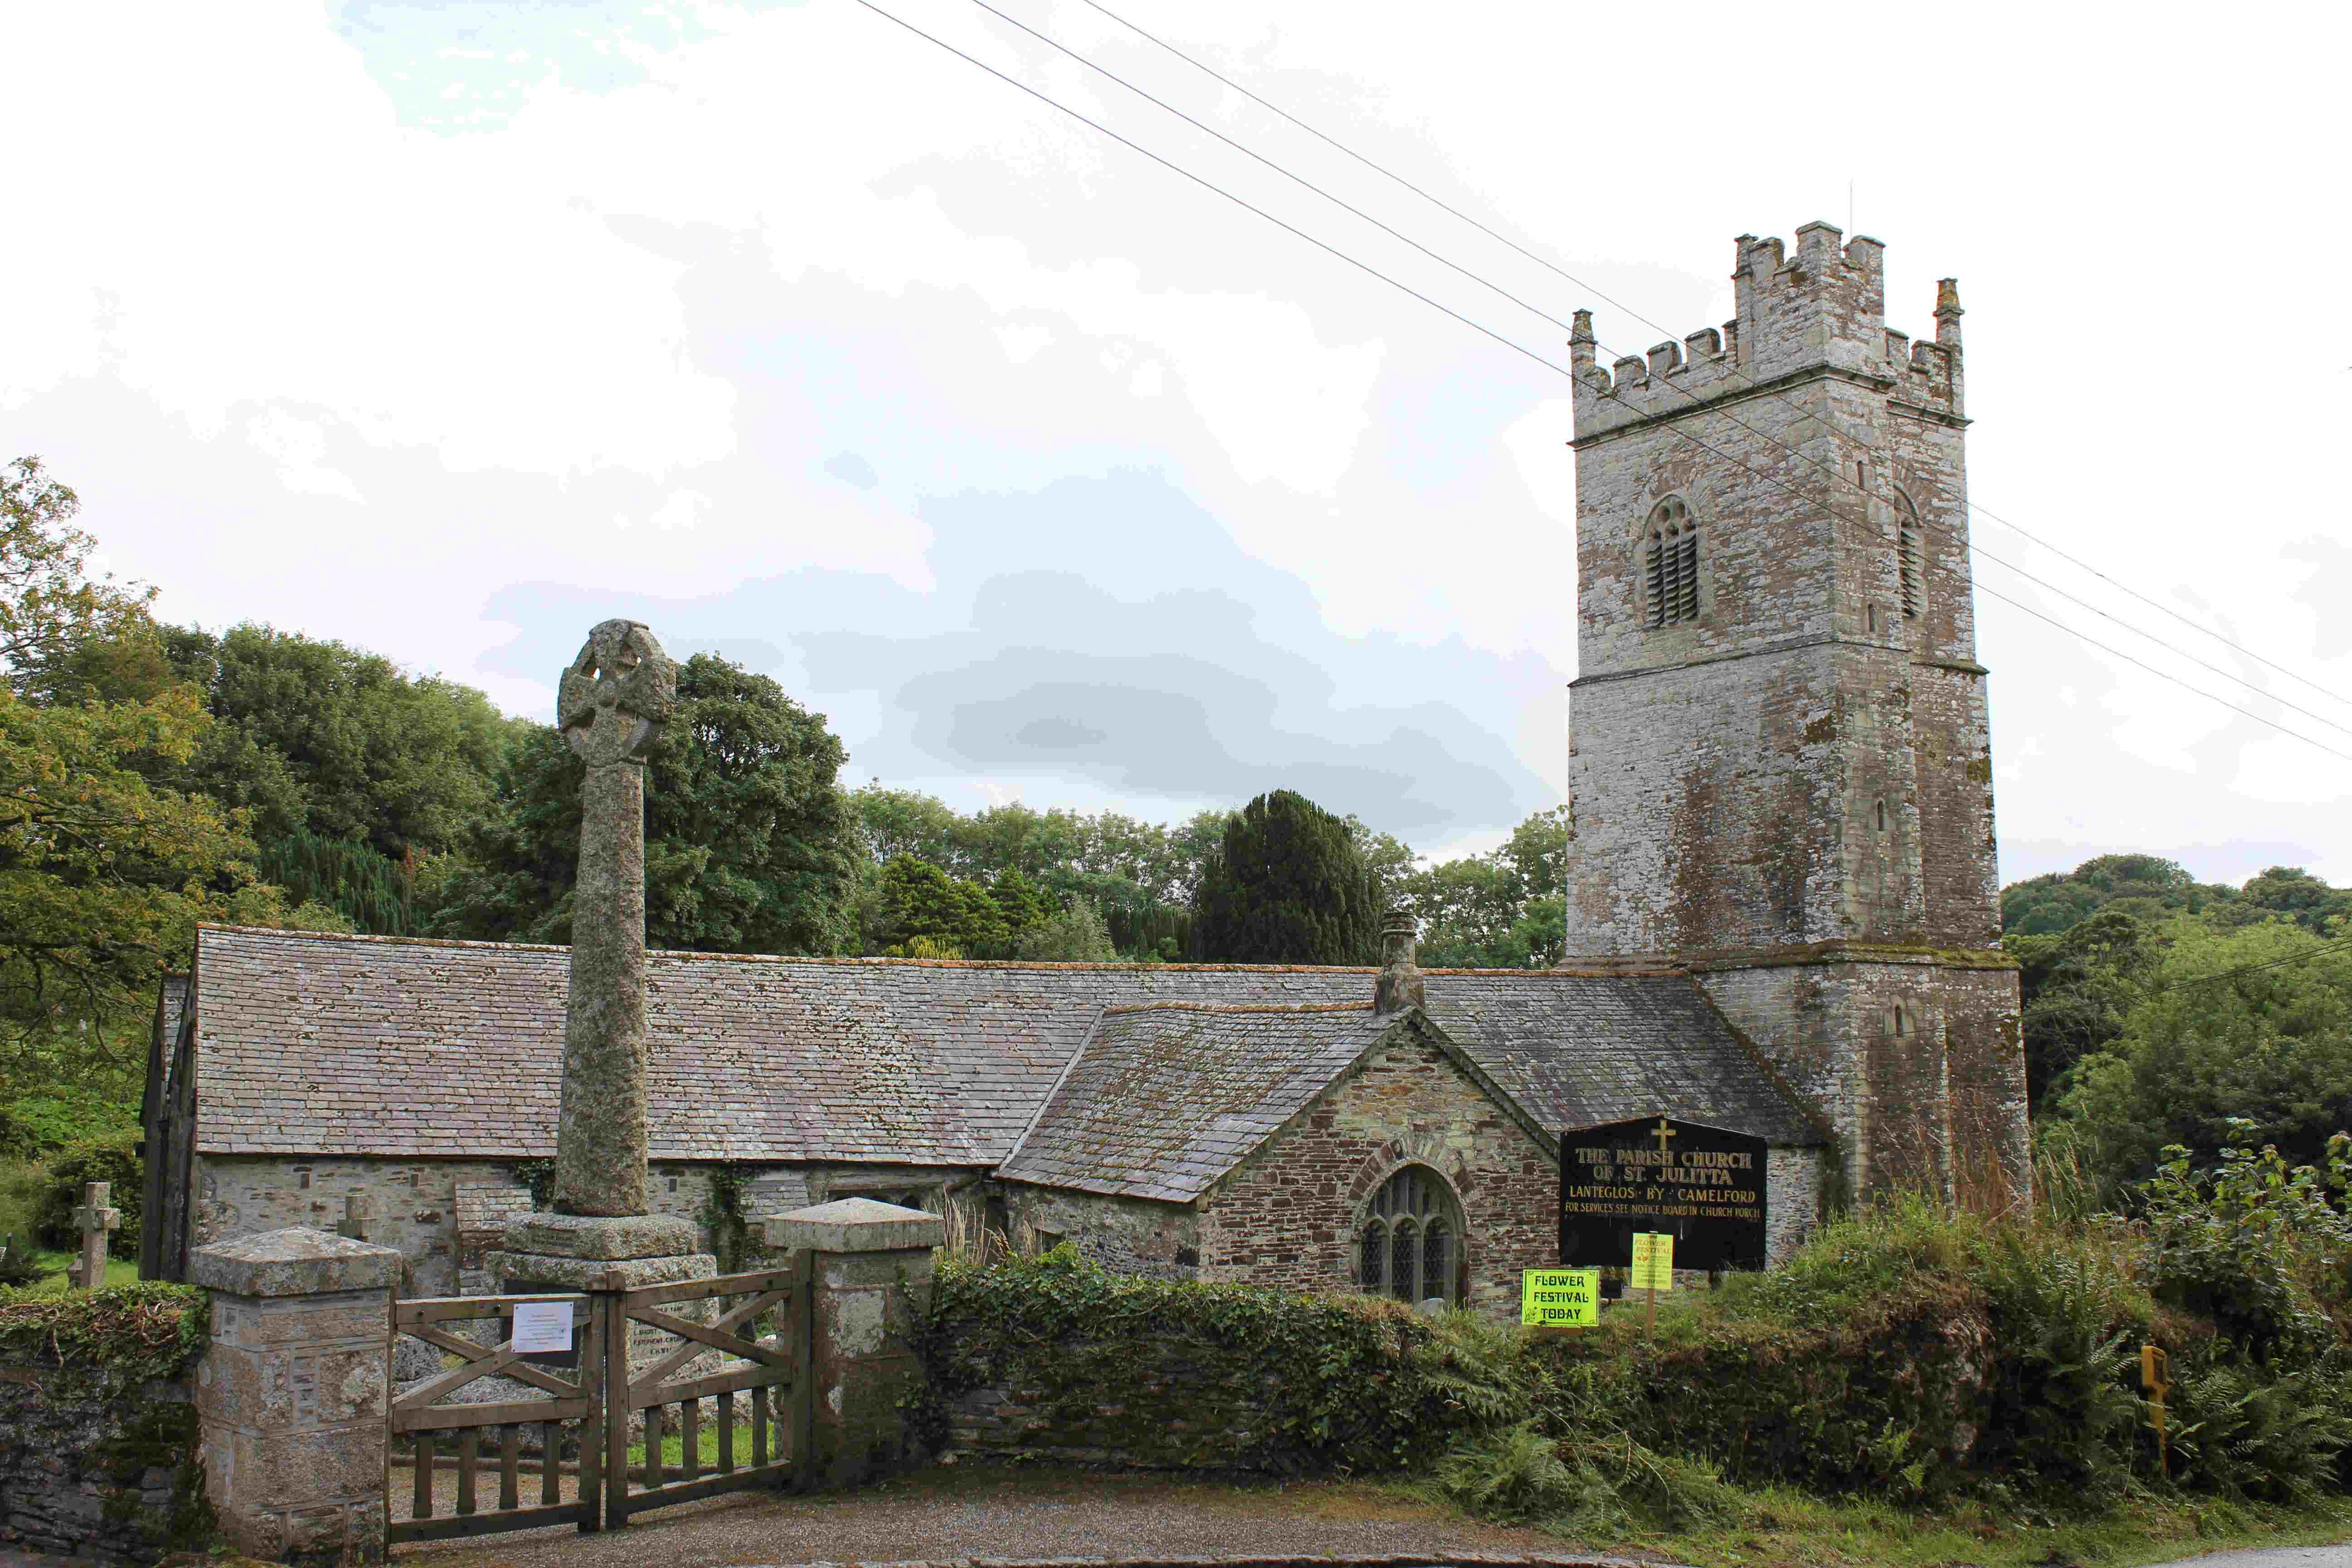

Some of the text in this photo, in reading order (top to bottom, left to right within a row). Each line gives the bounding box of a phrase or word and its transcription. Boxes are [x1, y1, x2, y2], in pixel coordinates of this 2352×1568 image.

[1575, 1147, 1752, 1169] THE PARISH CHURCH
[1593, 1165, 1613, 1181] OF
[1656, 1167, 1733, 1185] JULITTA
[1569, 1185, 1755, 1203] LANTEGLOS BY CAMELFORD
[1565, 1202, 1760, 1219] FOR SERVICES SEE NOTICE BOARD IN CHURCH PORCH
[1535, 1276, 1584, 1287] FLOWER
[1534, 1292, 1588, 1303] FESTIVAL
[1541, 1308, 1581, 1319] TODAY
